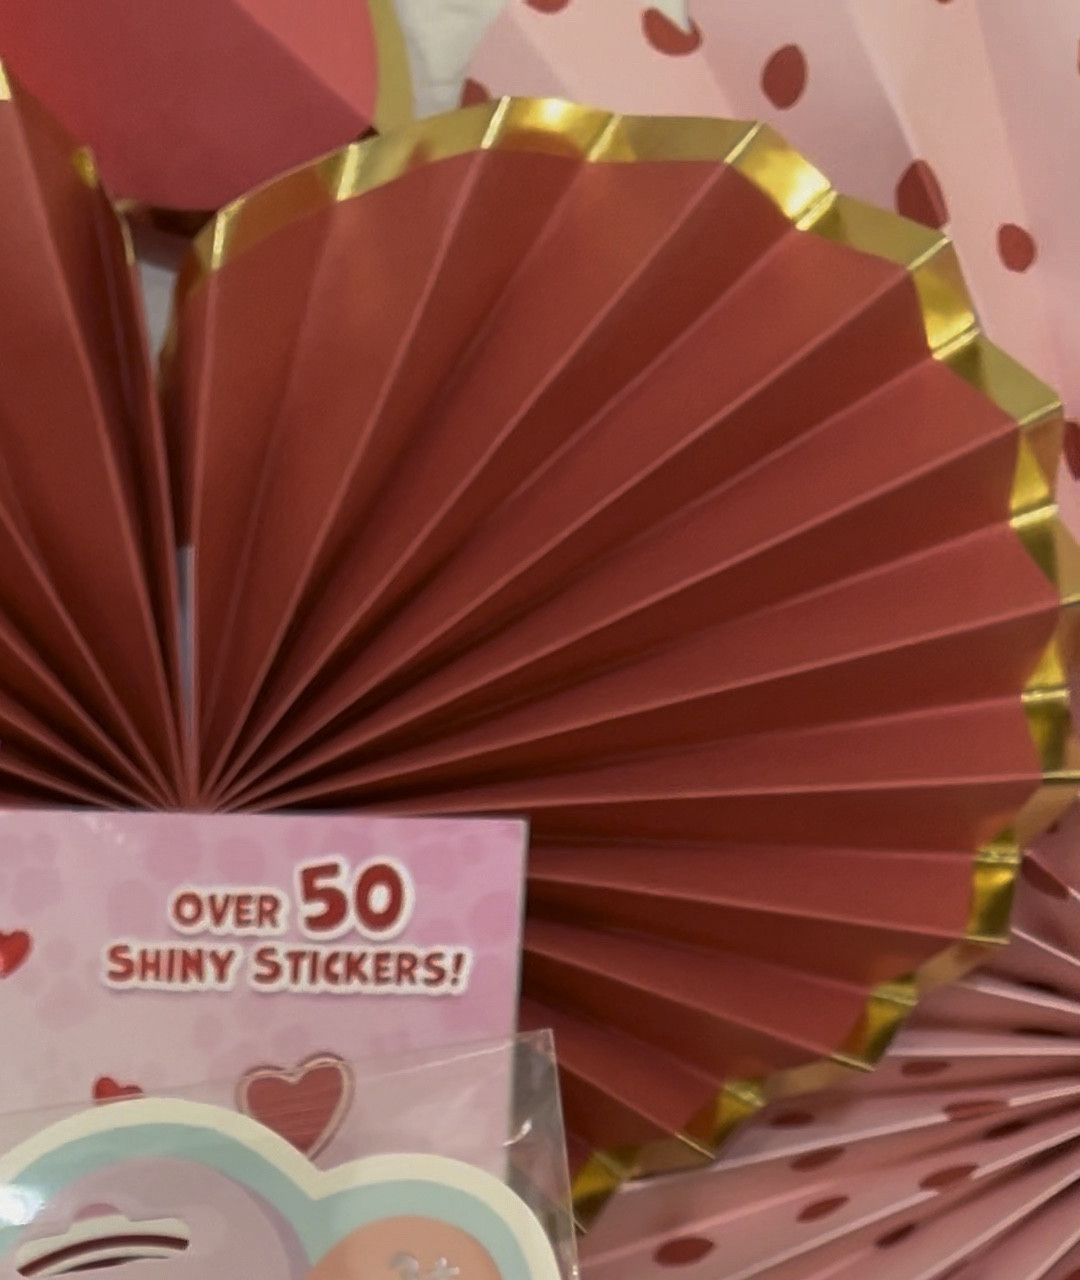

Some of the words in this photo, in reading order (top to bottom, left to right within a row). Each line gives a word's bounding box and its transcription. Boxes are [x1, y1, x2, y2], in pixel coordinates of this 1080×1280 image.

[173, 890, 281, 930] OVER
[300, 861, 405, 934] 50
[107, 944, 236, 985] SHINY
[253, 947, 466, 988] STICKERS!
